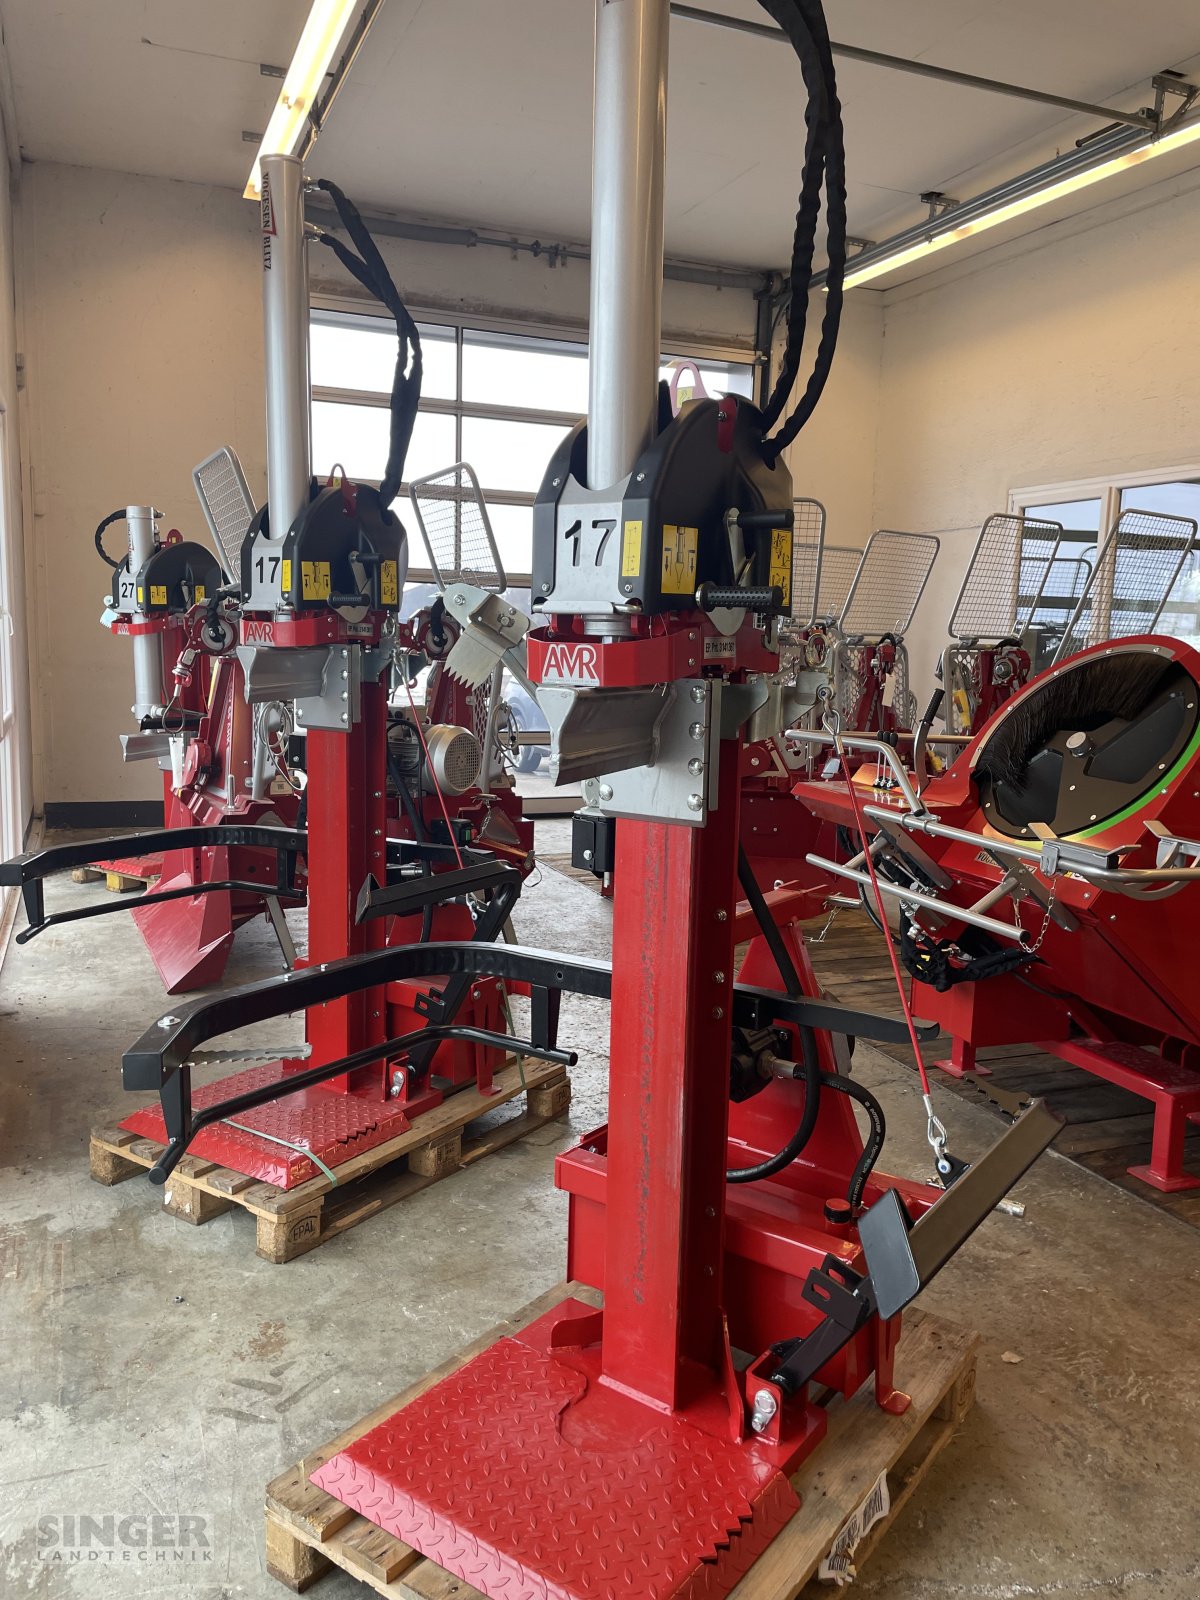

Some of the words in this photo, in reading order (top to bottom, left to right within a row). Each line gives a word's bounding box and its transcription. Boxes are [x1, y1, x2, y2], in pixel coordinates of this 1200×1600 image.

[262, 172, 271, 229] VOGESEN
[264, 235, 272, 272] BLITZ
[565, 519, 617, 567] 17
[256, 556, 281, 583] 17
[121, 582, 135, 598] 27
[246, 622, 274, 643] AMR
[543, 644, 599, 680] AMR
